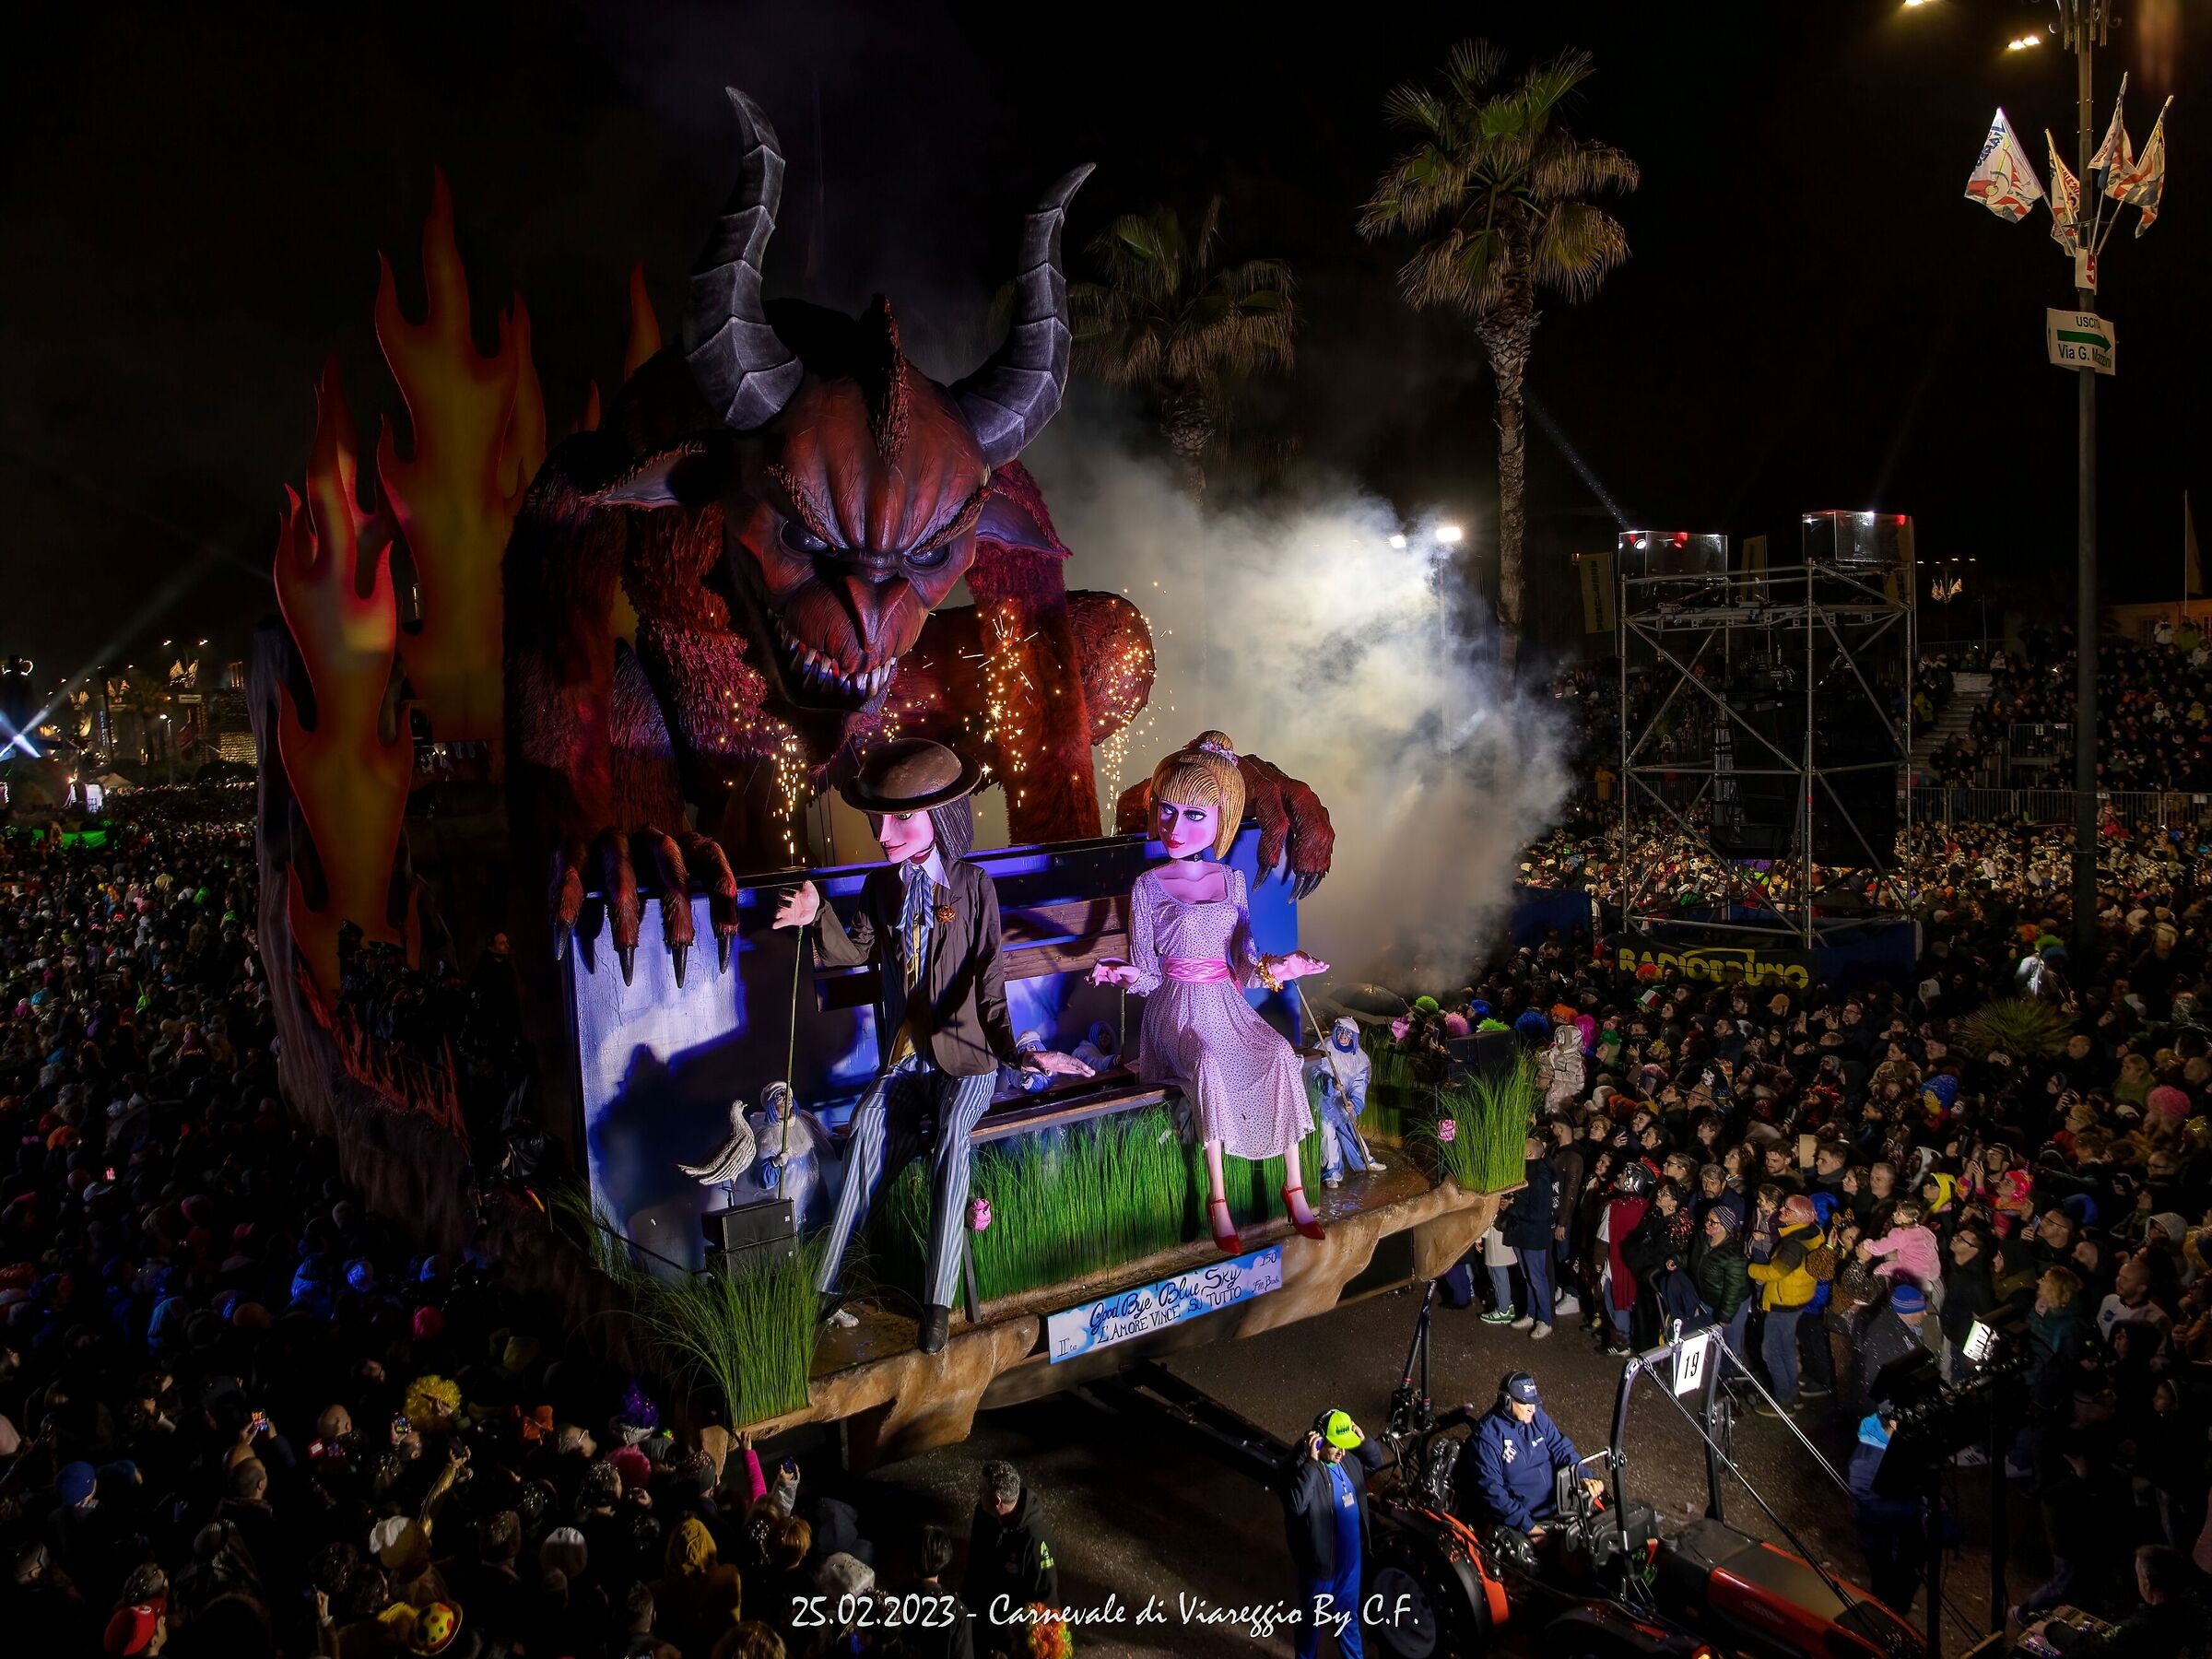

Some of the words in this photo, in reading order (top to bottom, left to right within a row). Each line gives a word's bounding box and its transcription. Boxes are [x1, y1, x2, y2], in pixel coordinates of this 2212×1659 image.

[2058, 344, 2076, 359] Via
[2078, 346, 2090, 360] G.
[1159, 1276, 1200, 1307] Blue
[1201, 1267, 1242, 1296] Sky
[1150, 1304, 1181, 1326] VINCE
[1187, 1298, 1203, 1312] SU
[1206, 1286, 1242, 1307] TUTTO
[1684, 1351, 1700, 1379] 19
